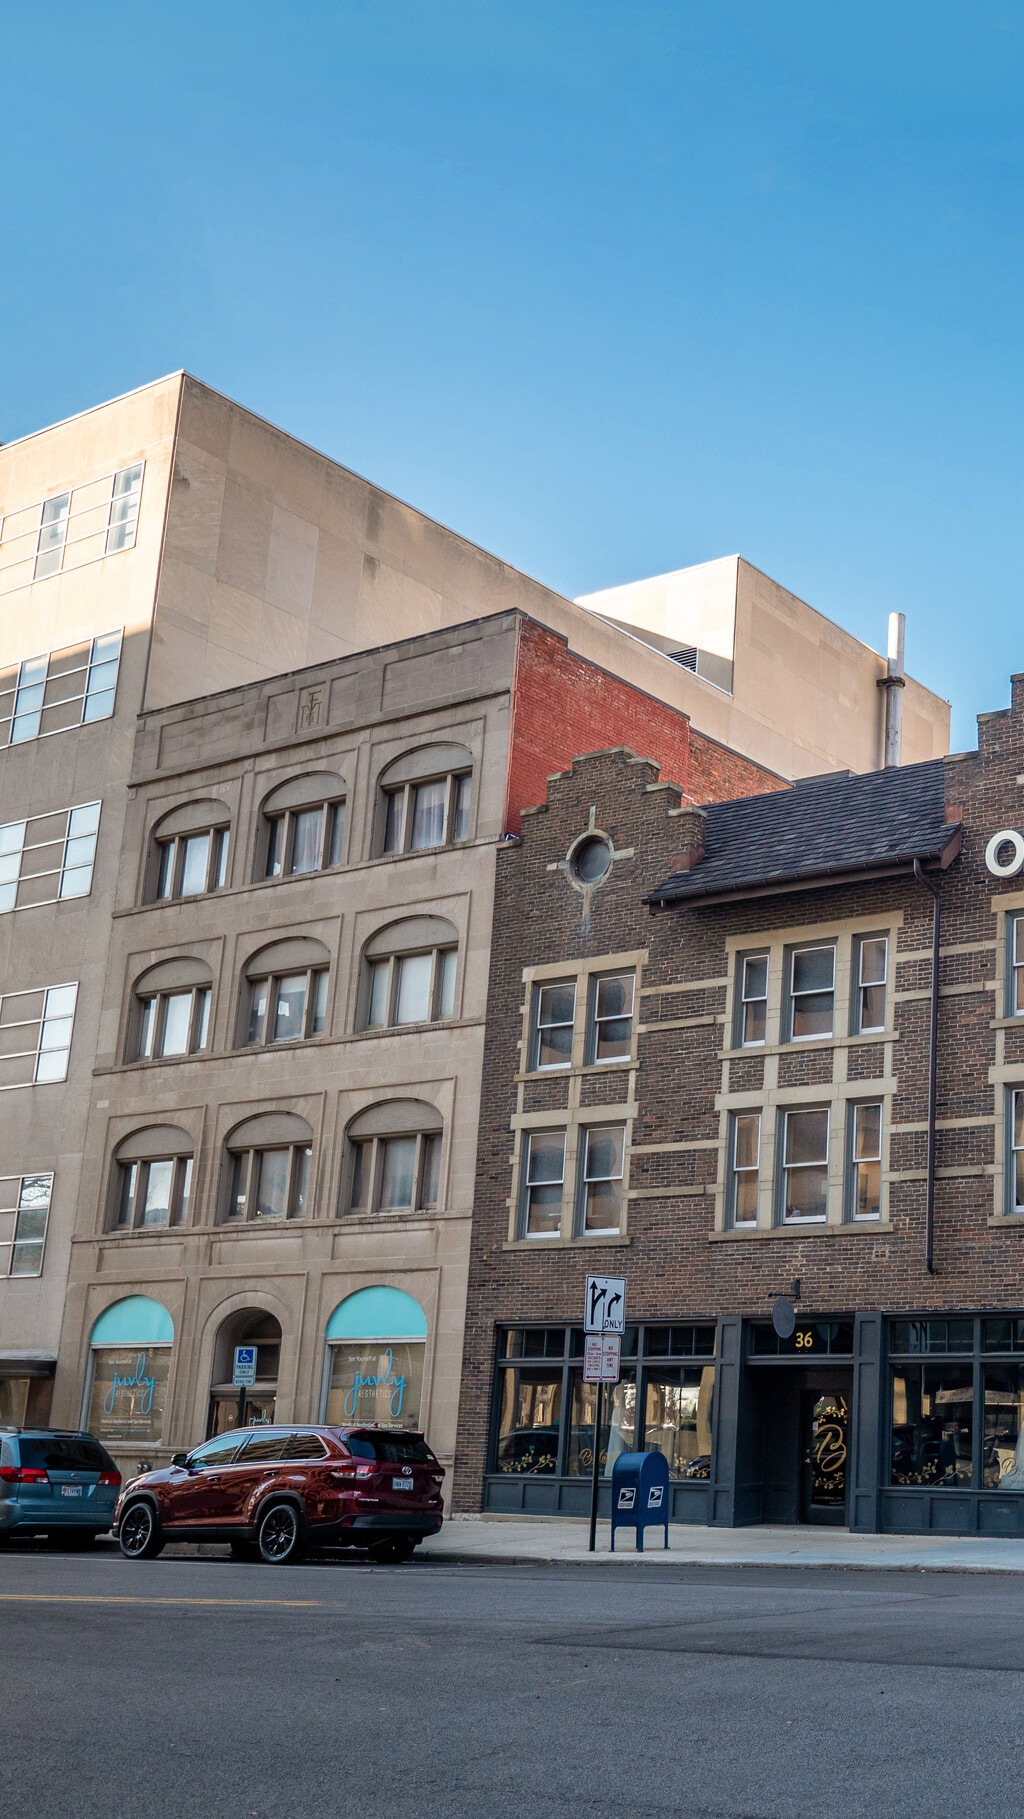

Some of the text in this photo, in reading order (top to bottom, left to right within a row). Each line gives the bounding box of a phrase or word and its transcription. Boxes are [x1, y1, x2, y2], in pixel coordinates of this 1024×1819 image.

[604, 1319, 623, 1329] ONLY
[795, 1332, 813, 1348] 36
[103, 1352, 156, 1415] juvly
[343, 1347, 407, 1417] juvly
[357, 1389, 393, 1398] AESTHETICS
